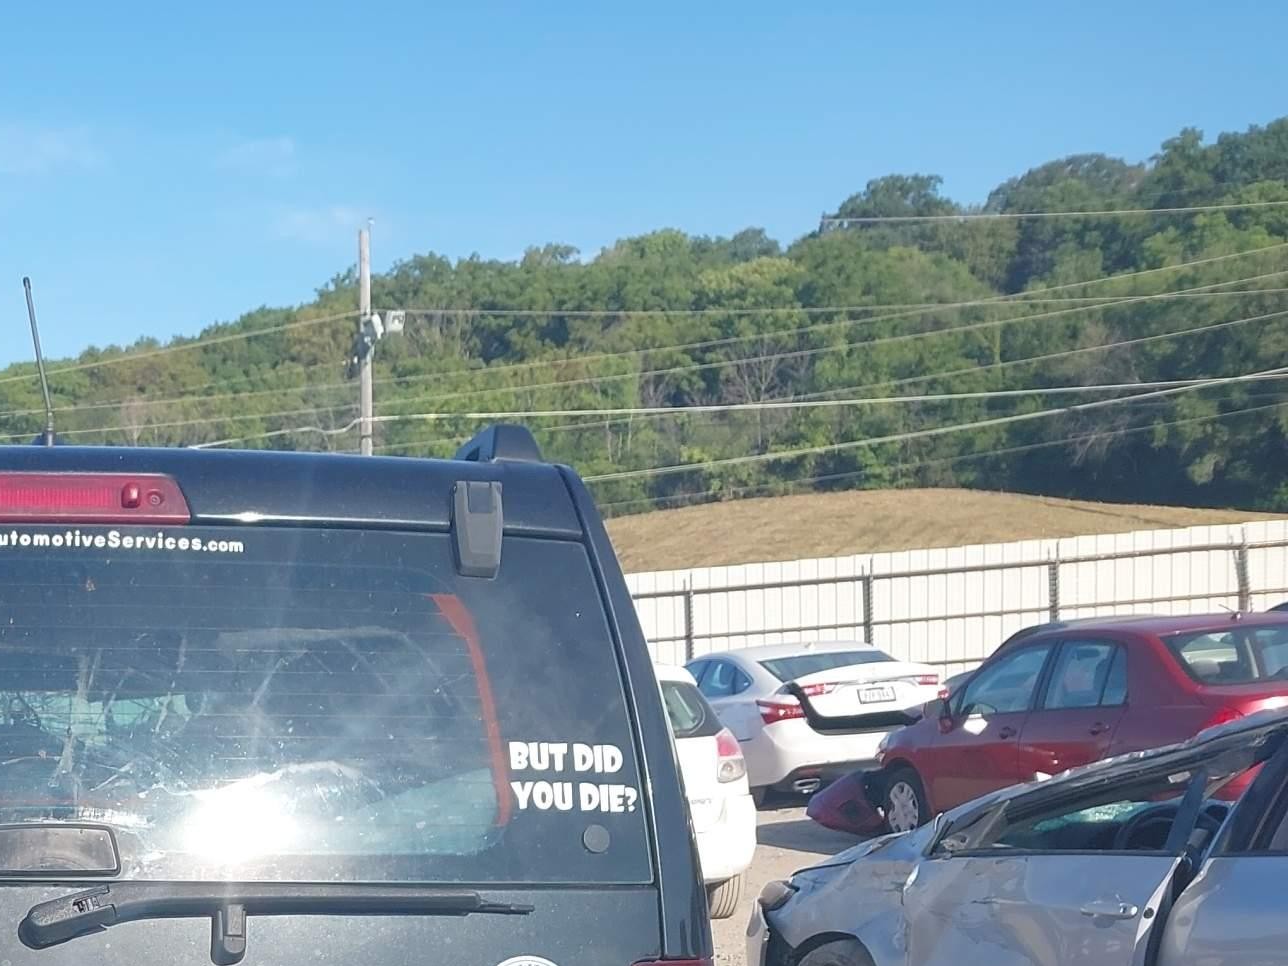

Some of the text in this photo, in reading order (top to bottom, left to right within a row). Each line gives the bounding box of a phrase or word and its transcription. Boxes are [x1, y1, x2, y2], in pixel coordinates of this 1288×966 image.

[508, 741, 624, 773] BUT DID
[510, 780, 638, 813] YOU DIE?
